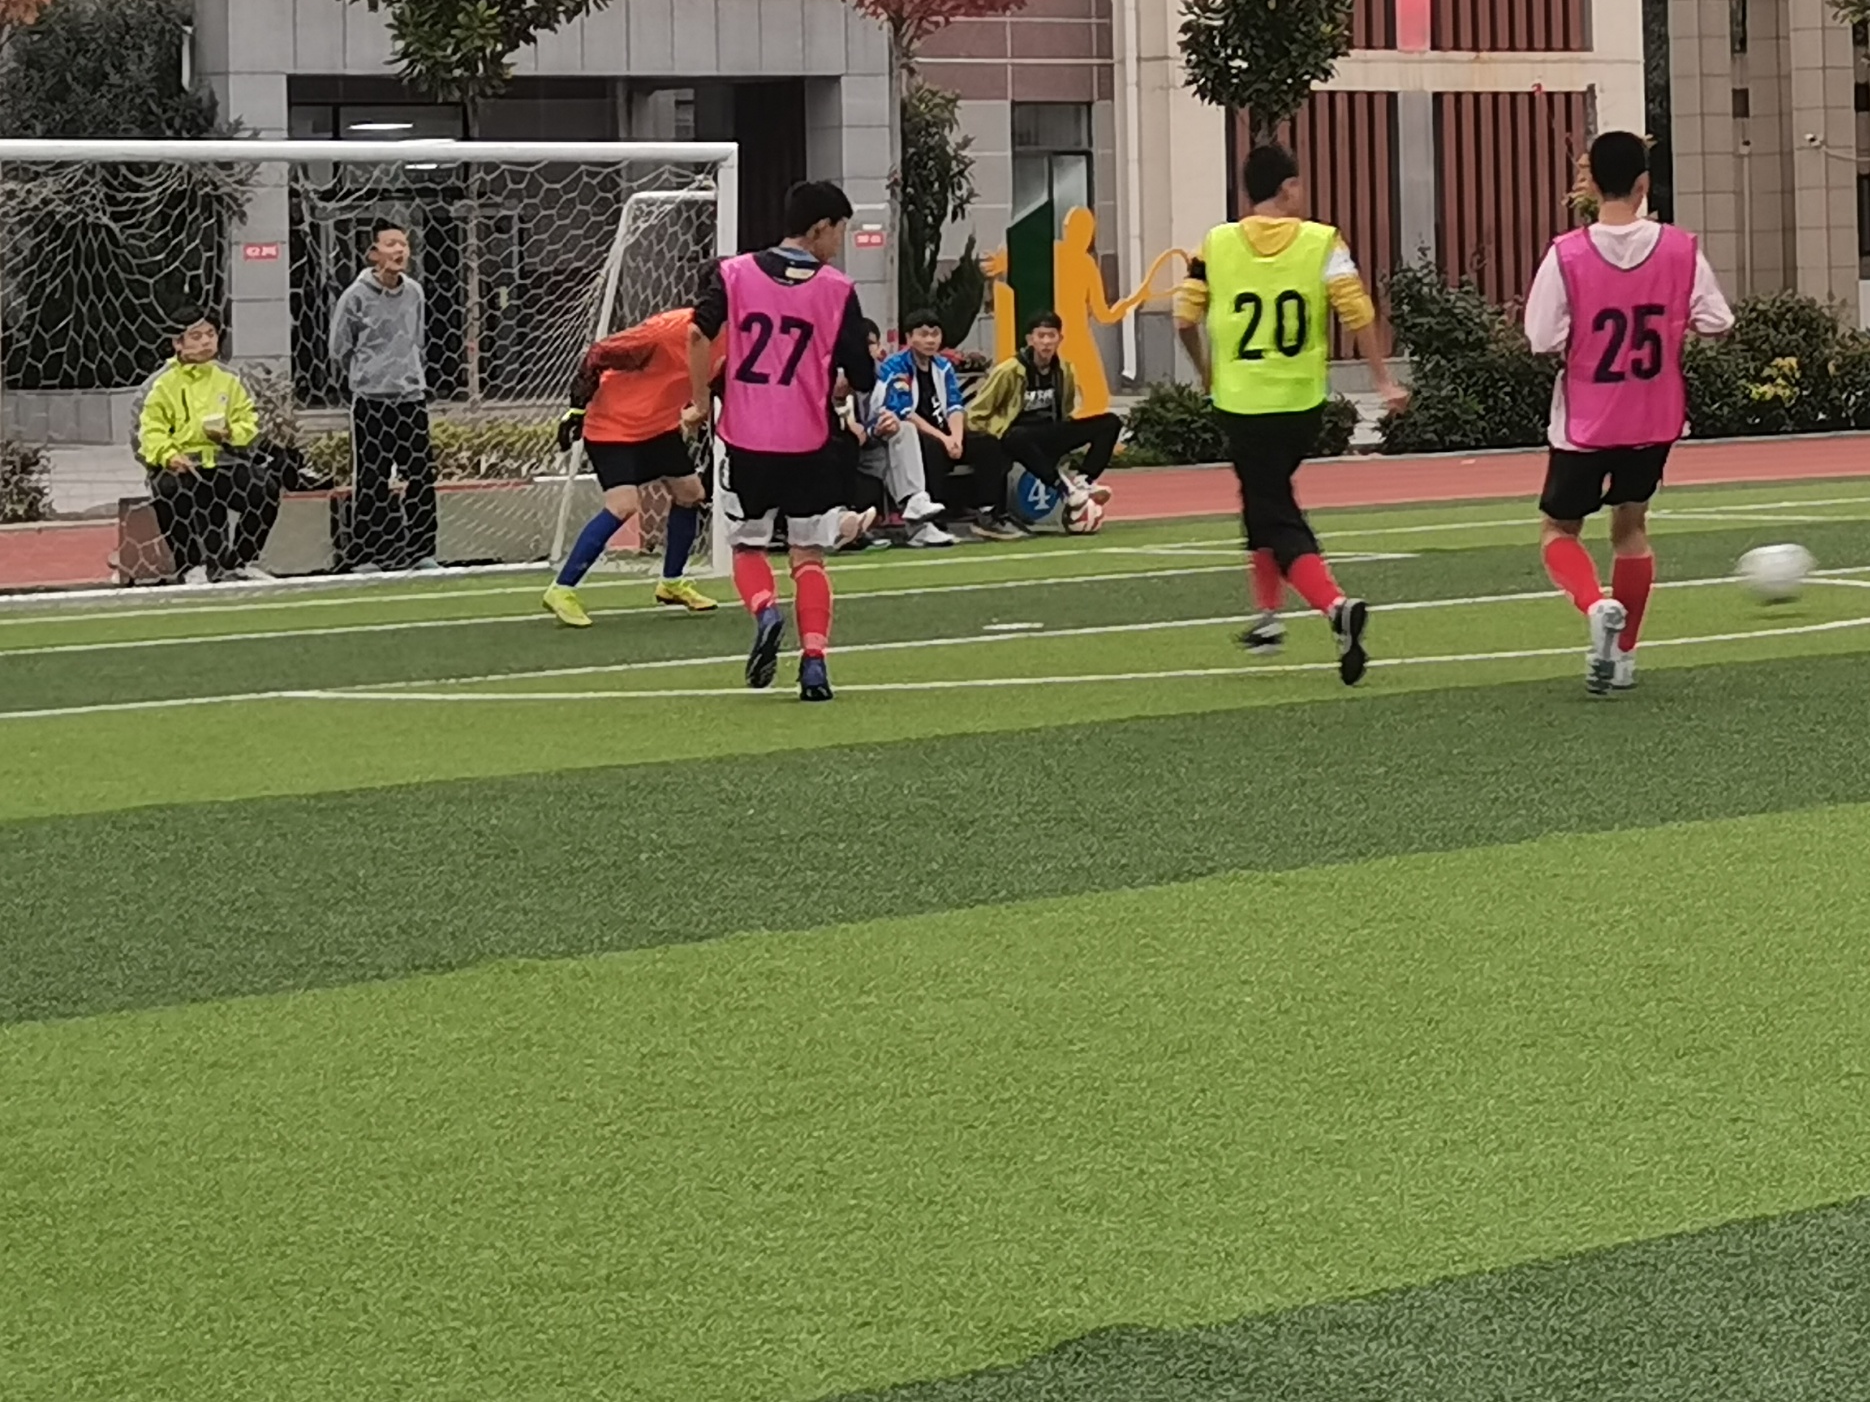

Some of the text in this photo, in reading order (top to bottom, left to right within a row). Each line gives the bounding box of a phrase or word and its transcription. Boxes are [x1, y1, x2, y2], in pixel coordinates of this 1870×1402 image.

[735, 311, 815, 386] 27
[1233, 289, 1307, 360] 20
[1591, 303, 1666, 383] 25
[1028, 478, 1051, 510] 4
